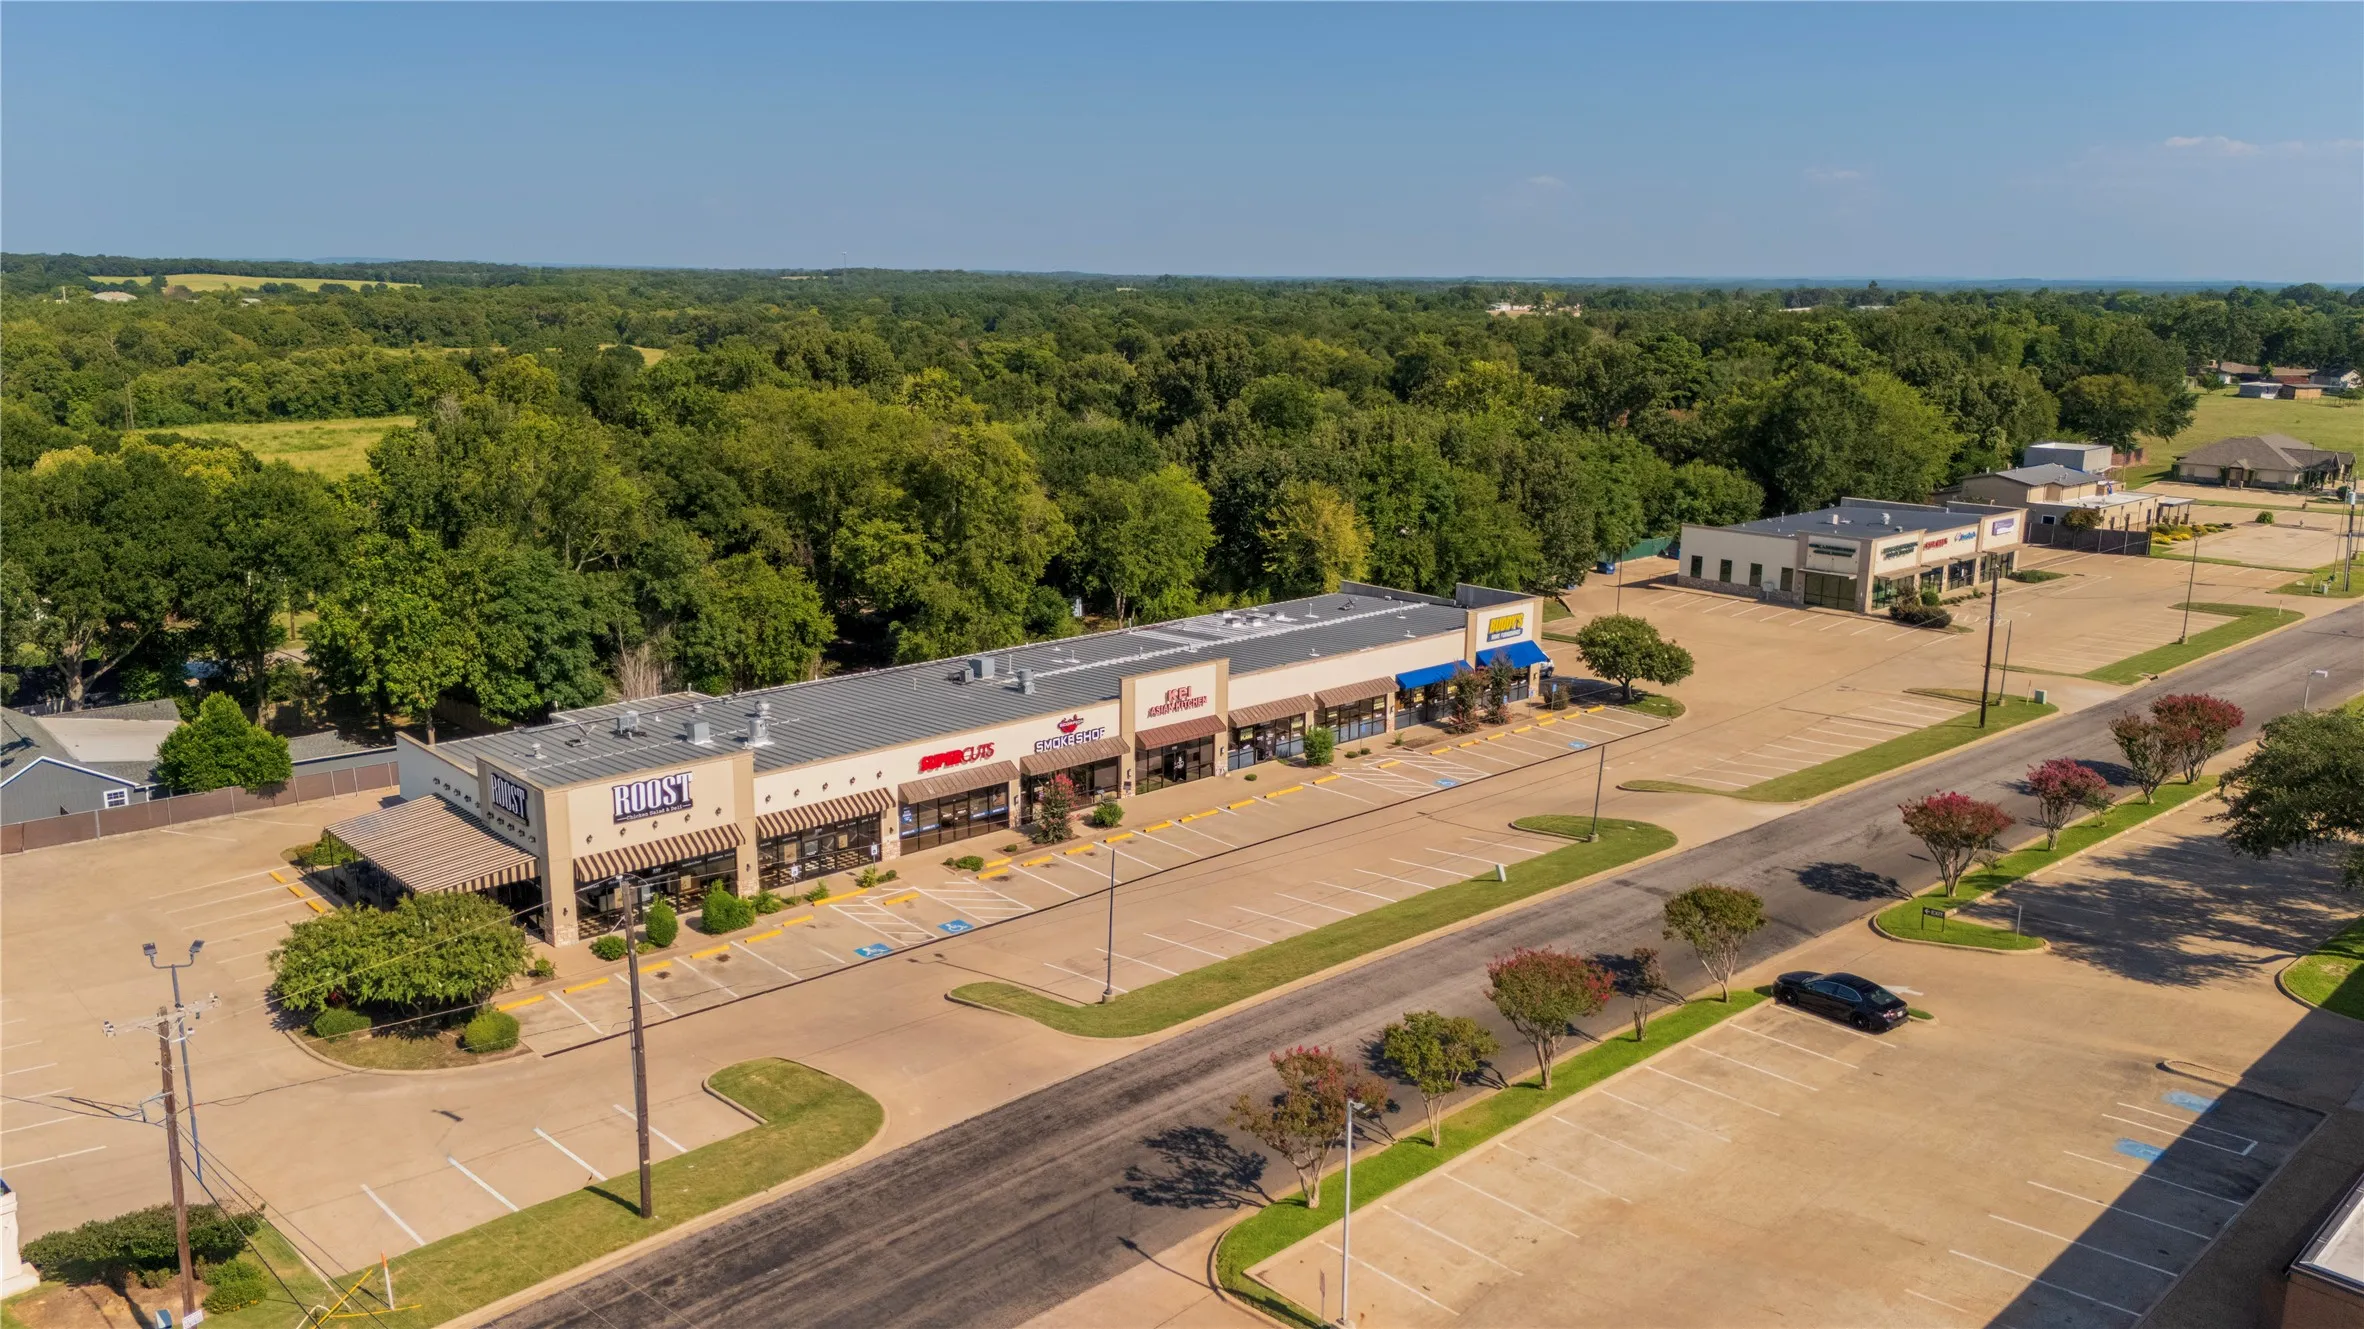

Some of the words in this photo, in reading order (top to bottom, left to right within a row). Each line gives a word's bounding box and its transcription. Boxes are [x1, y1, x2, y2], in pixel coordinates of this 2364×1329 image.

[1490, 613, 1524, 633] BUDDY'S
[1148, 702, 1173, 717] ASIAN
[1174, 696, 1207, 711] KITCHEN
[1166, 686, 1192, 702] KEI
[919, 742, 995, 772] SUPERCUTS
[491, 774, 525, 819] ROOST
[613, 771, 693, 816] ROOST
